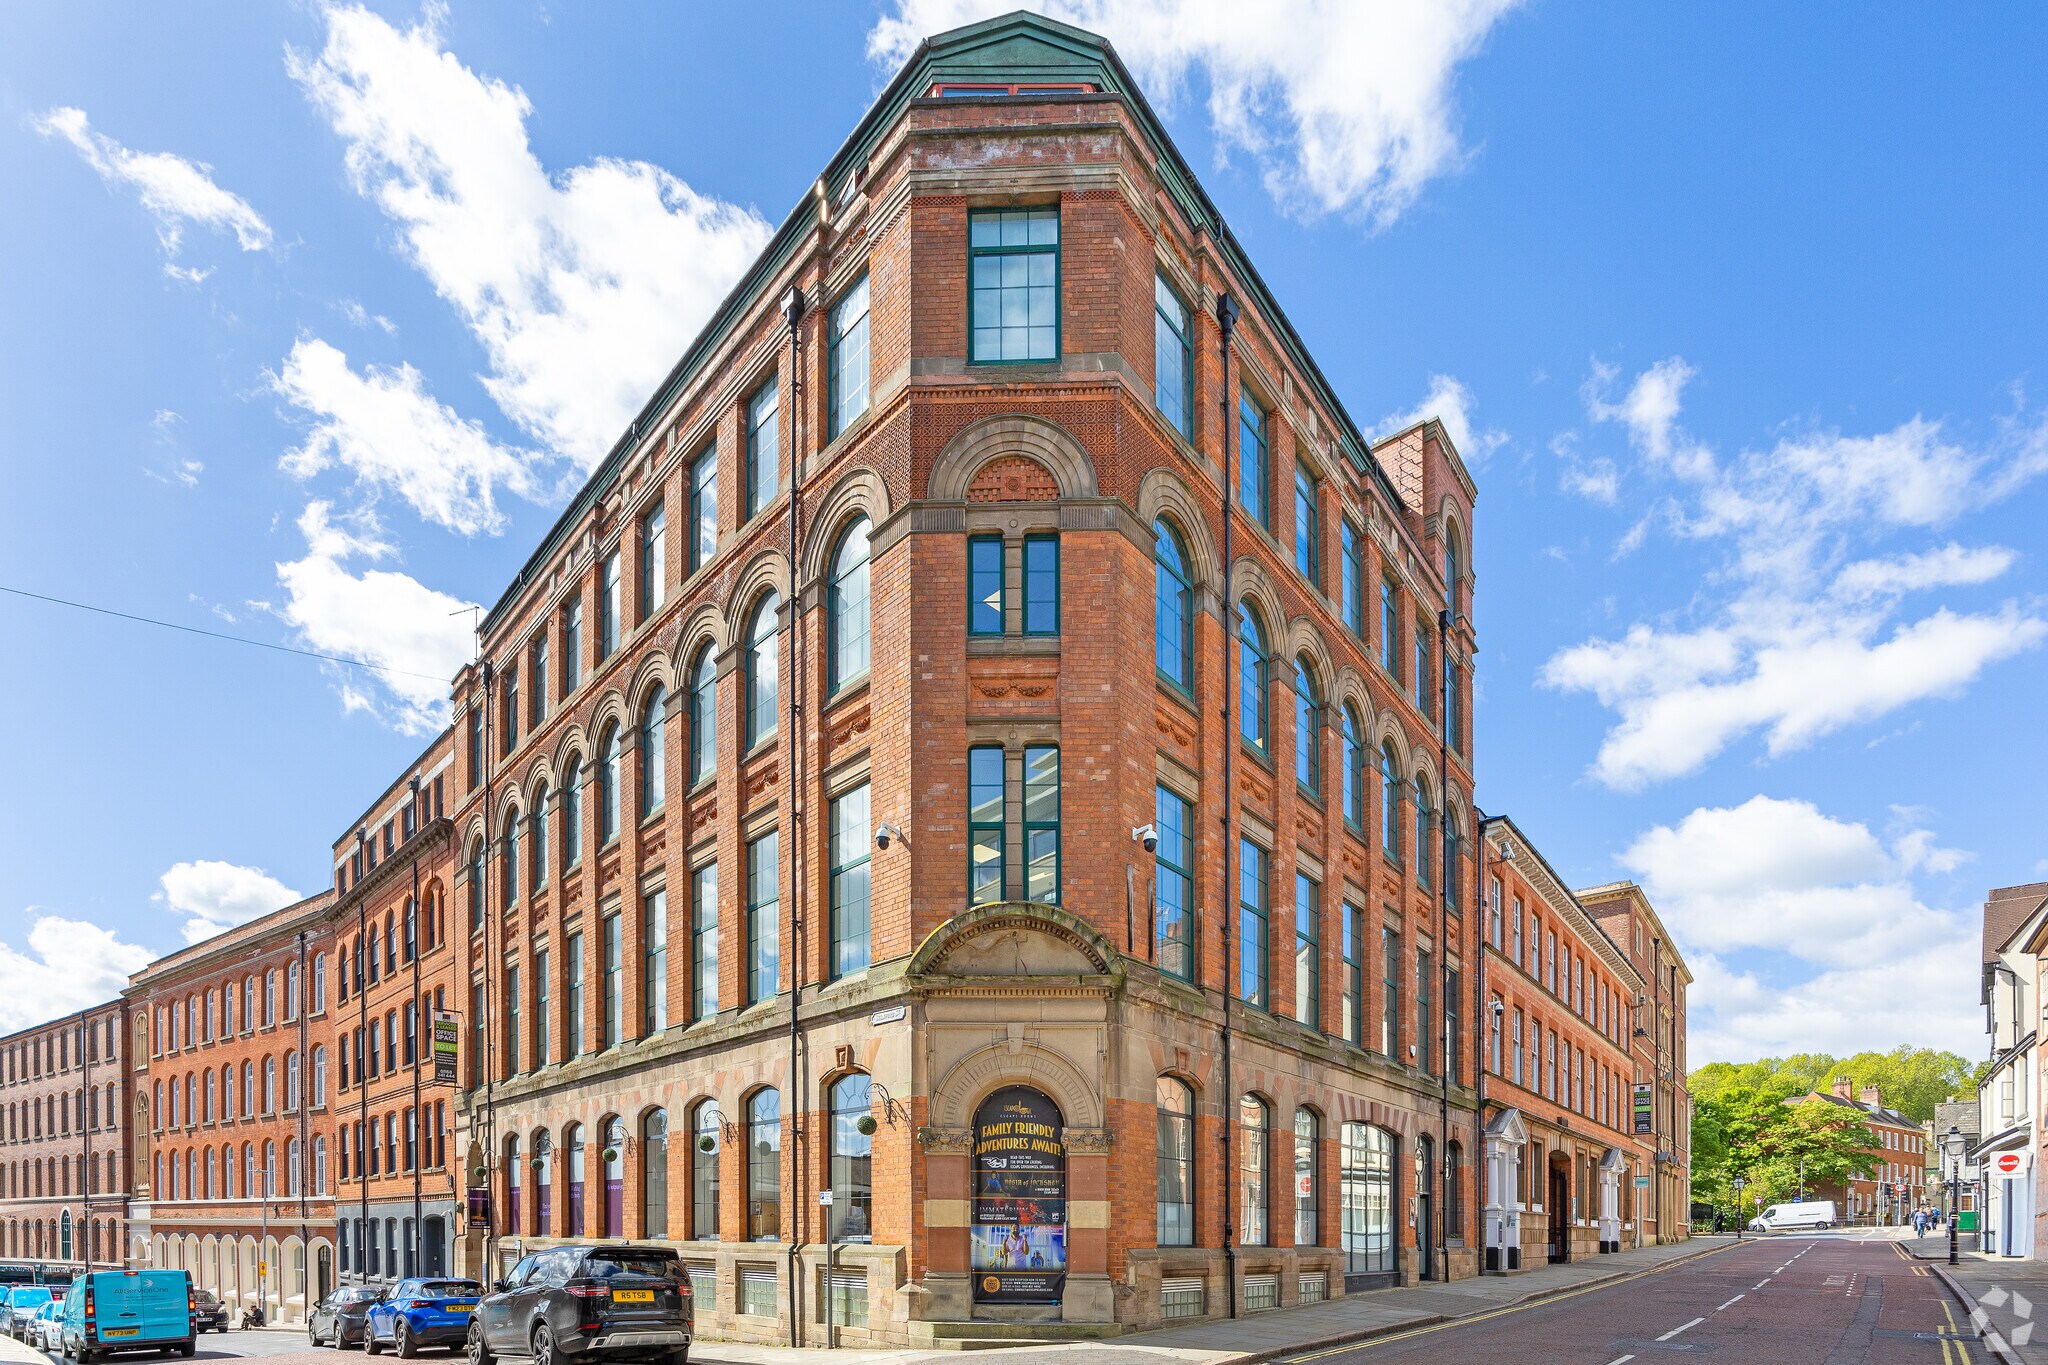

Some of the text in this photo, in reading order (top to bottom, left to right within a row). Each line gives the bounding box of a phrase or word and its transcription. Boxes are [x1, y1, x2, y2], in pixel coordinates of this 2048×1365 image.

[982, 1121, 1055, 1138] FAMILY FRIENDLY
[976, 1137, 1061, 1156] ADVENTURES AWAIT!
